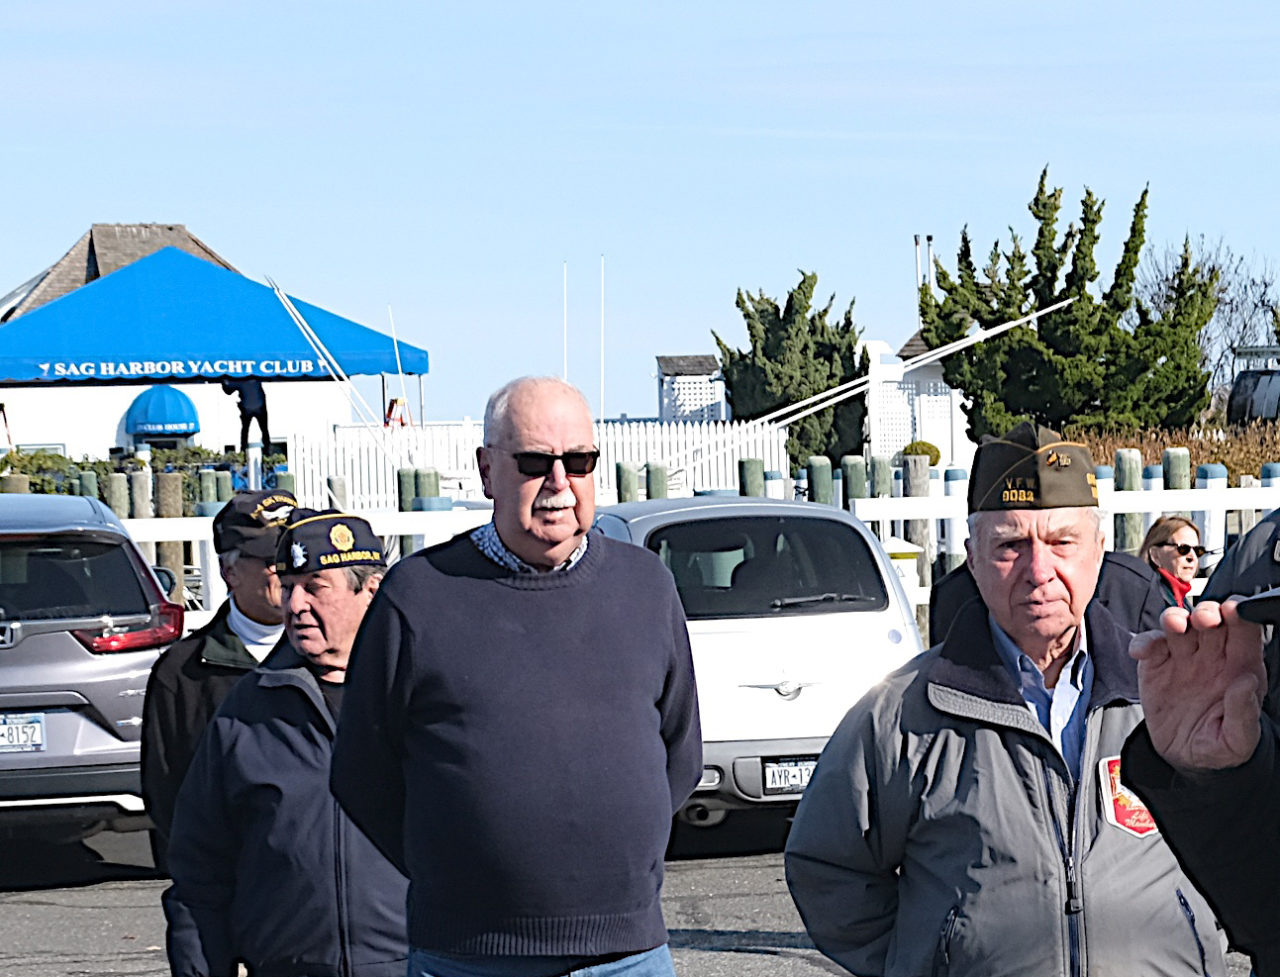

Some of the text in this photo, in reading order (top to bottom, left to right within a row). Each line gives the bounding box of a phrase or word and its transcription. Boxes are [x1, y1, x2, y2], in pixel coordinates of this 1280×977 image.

[54, 360, 314, 376] SAG HARBOR YACHT CLUB
[320, 554, 338, 565] SAG
[7, 725, 37, 744] 8152
